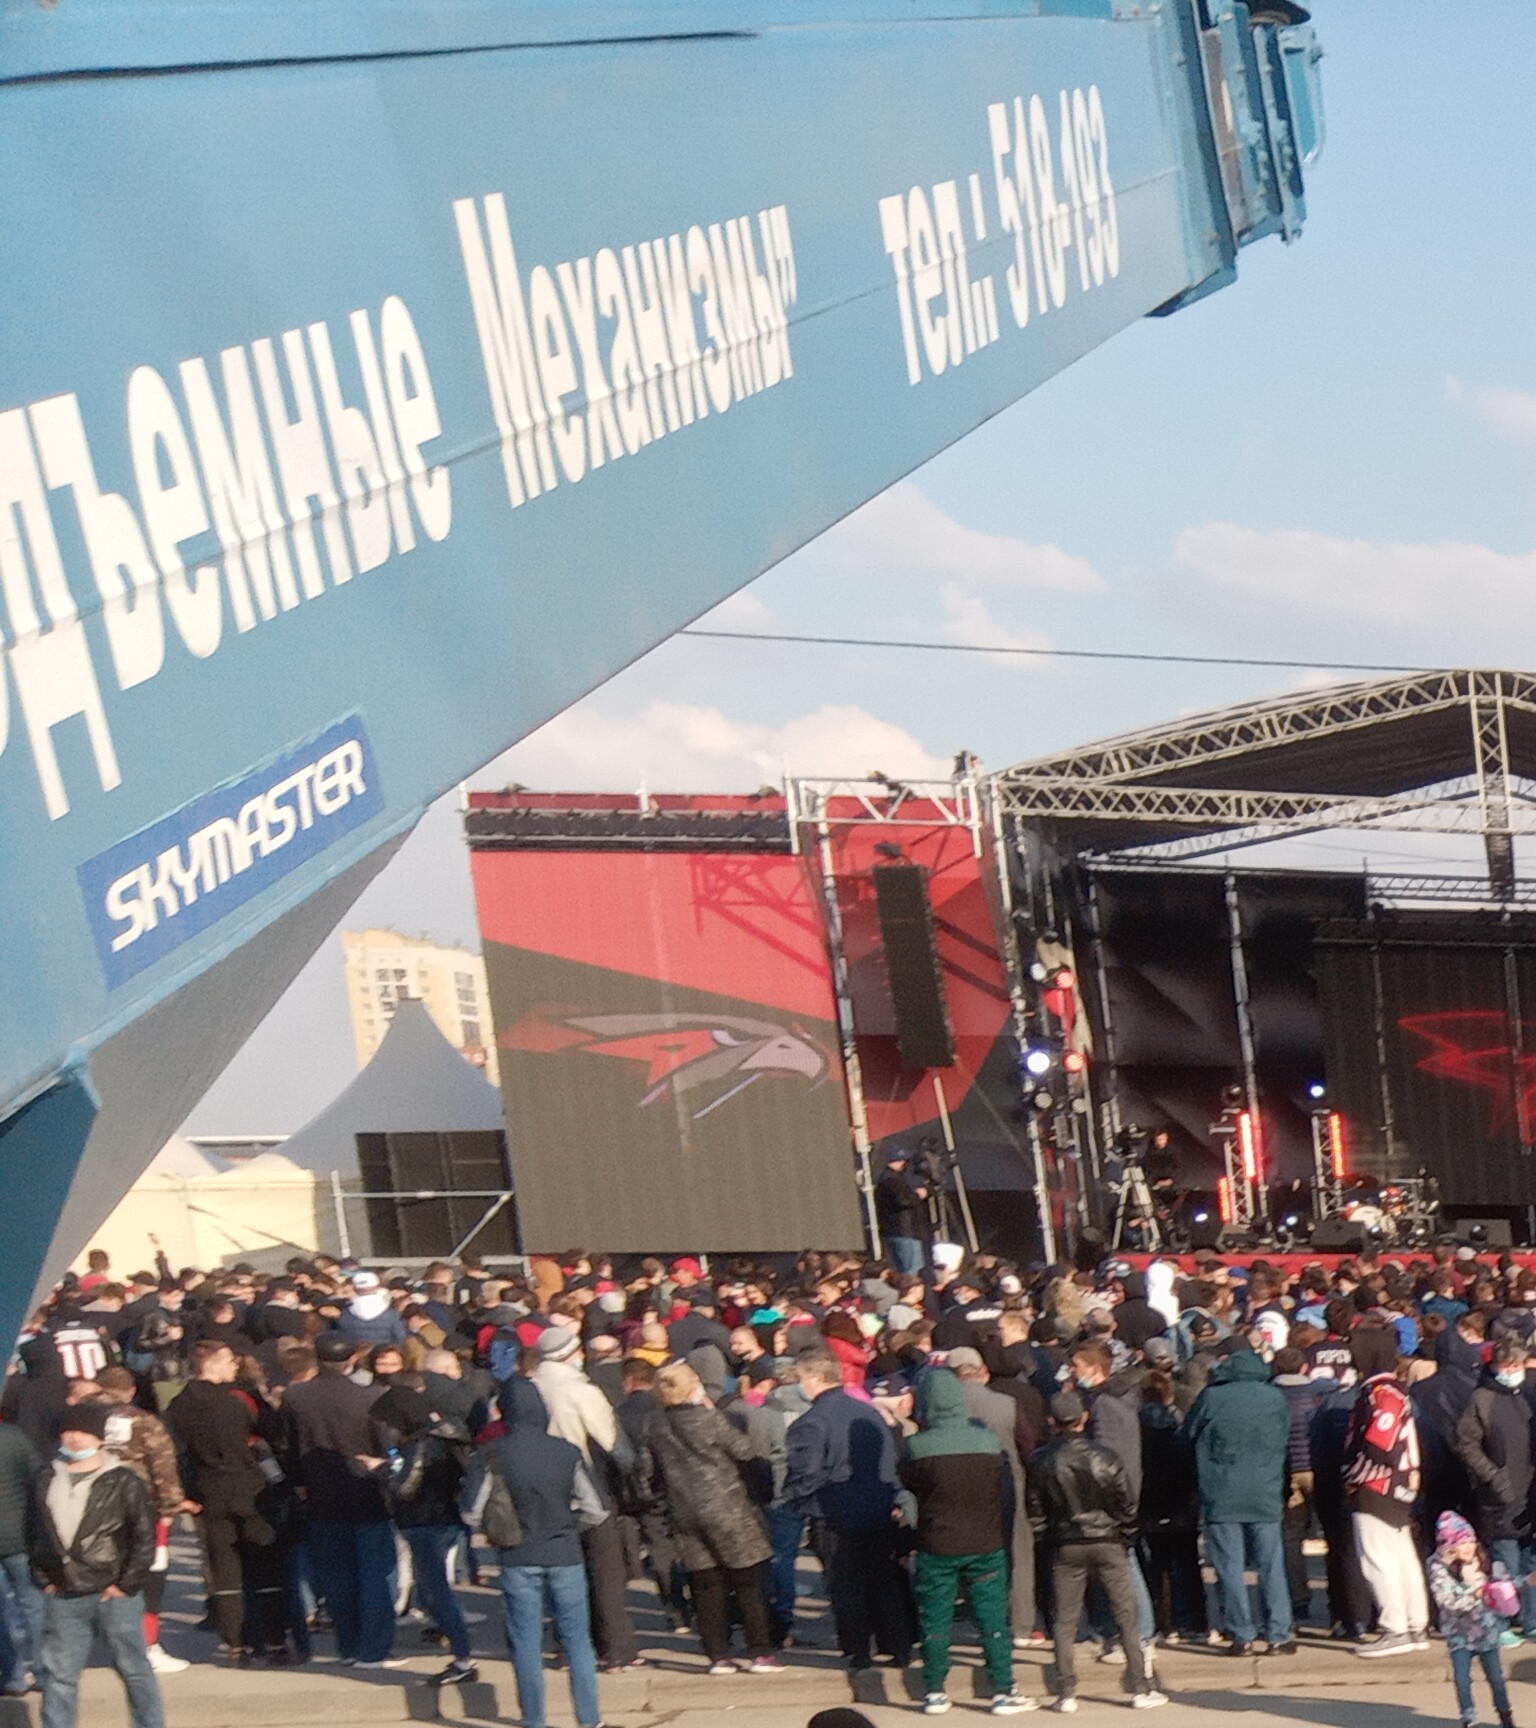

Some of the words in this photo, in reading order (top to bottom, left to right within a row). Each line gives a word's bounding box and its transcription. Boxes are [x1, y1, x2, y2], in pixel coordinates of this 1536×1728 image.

[0, 296, 452, 822] дъемные
[988, 84, 1120, 329] 518-193
[106, 738, 367, 954] SKYMASTER
